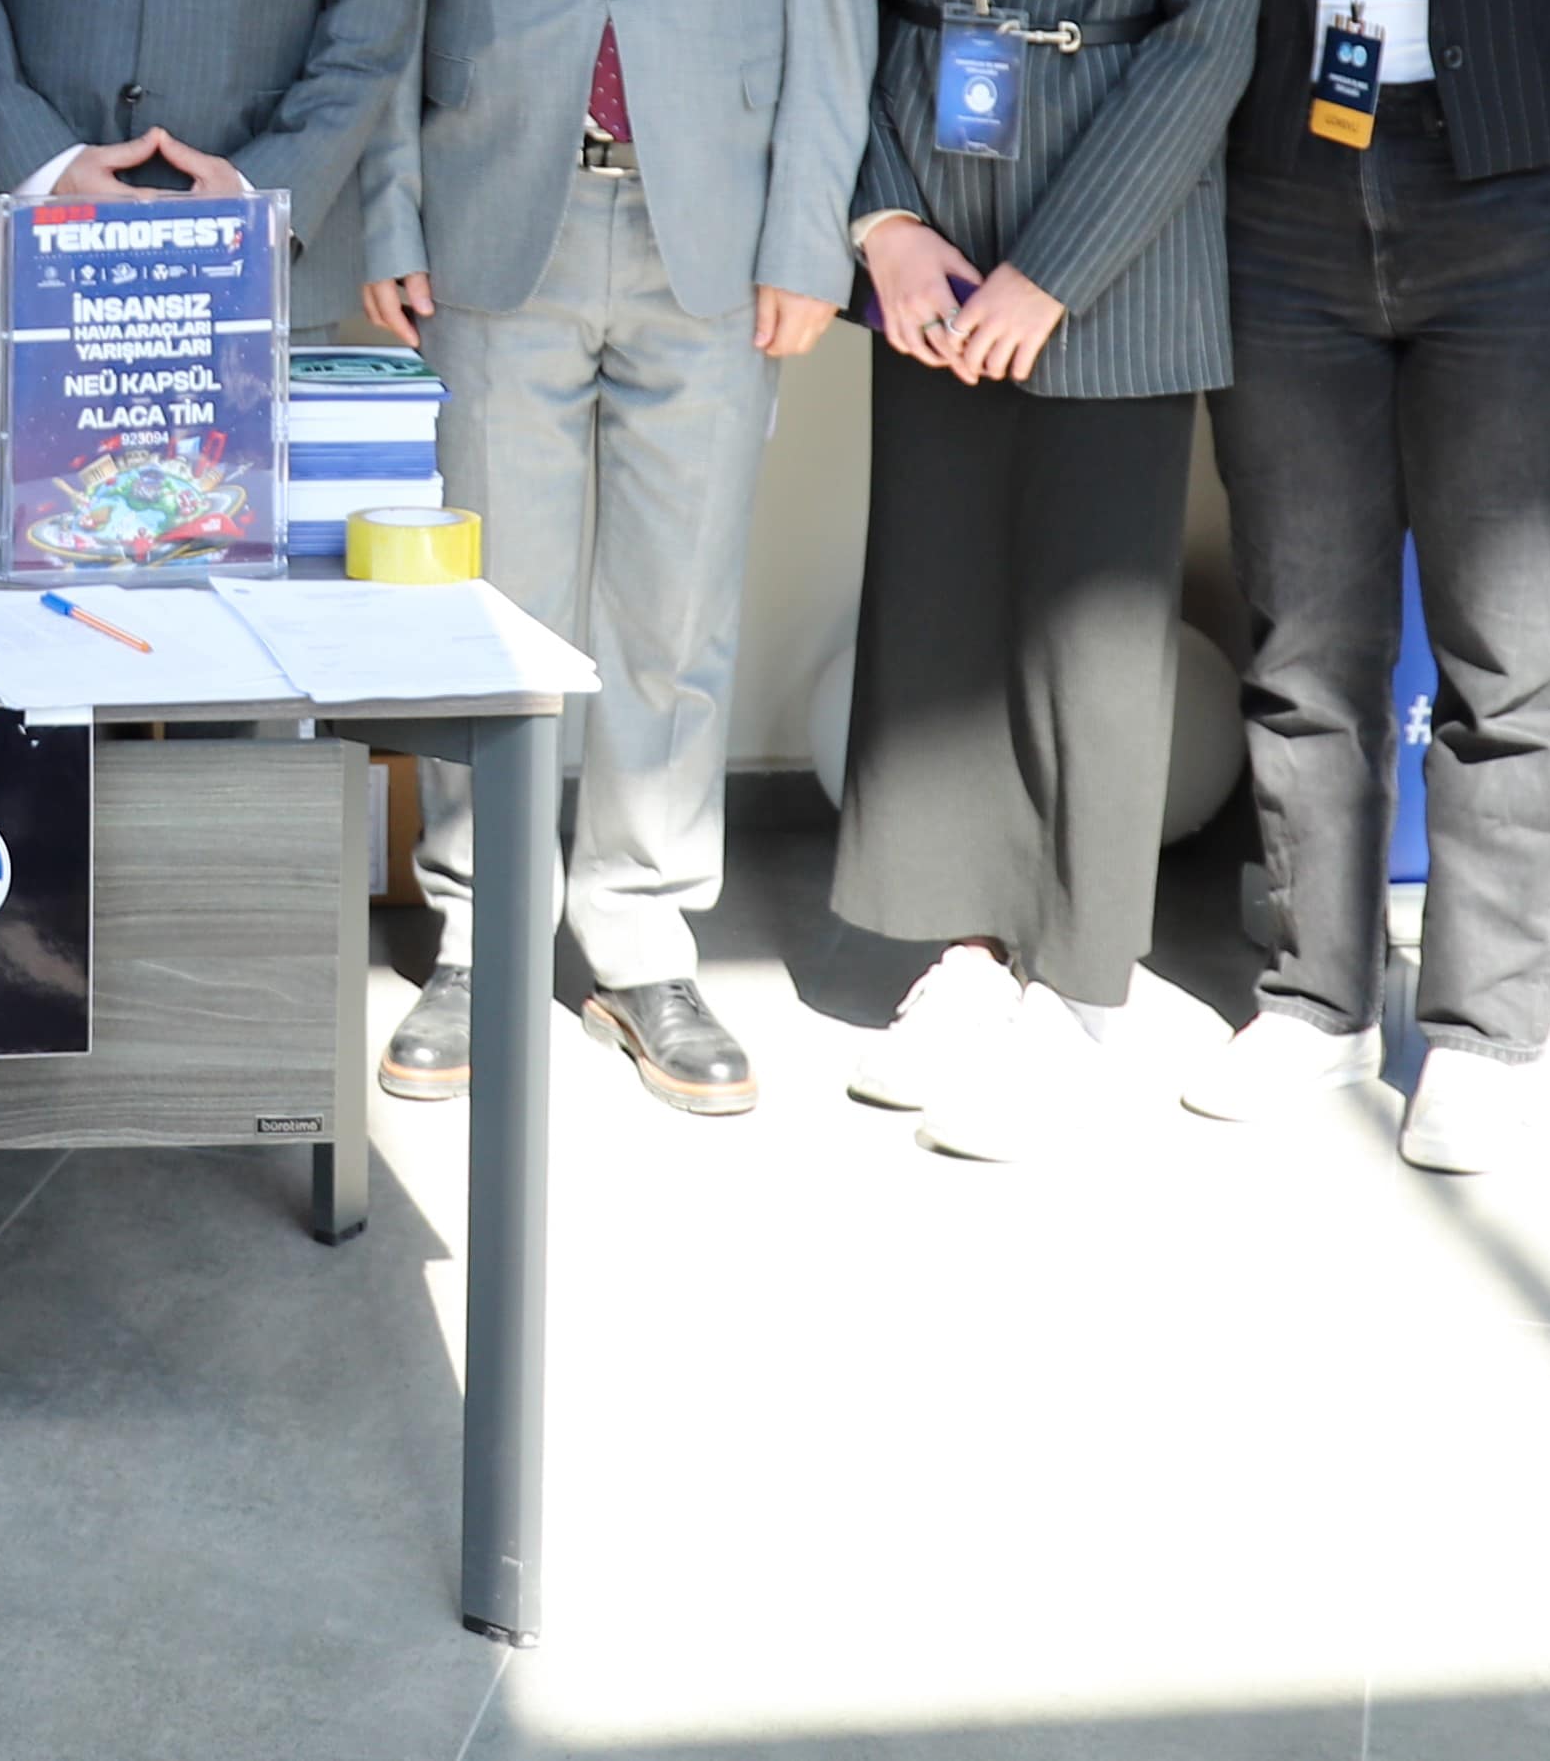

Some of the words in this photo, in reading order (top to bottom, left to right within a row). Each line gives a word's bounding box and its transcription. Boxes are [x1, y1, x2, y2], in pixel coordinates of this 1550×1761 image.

[32, 216, 244, 253] TEKNOFEST
[72, 292, 212, 323] İNSANSIZ
[74, 323, 123, 341] HAVA
[125, 320, 212, 345] ARAÇLARI
[75, 338, 212, 364] YARIŞMALARI
[64, 368, 117, 397] NEÜ
[121, 364, 222, 395] KAPSÜL
[78, 403, 166, 429] ALACA
[169, 398, 215, 424] TİM
